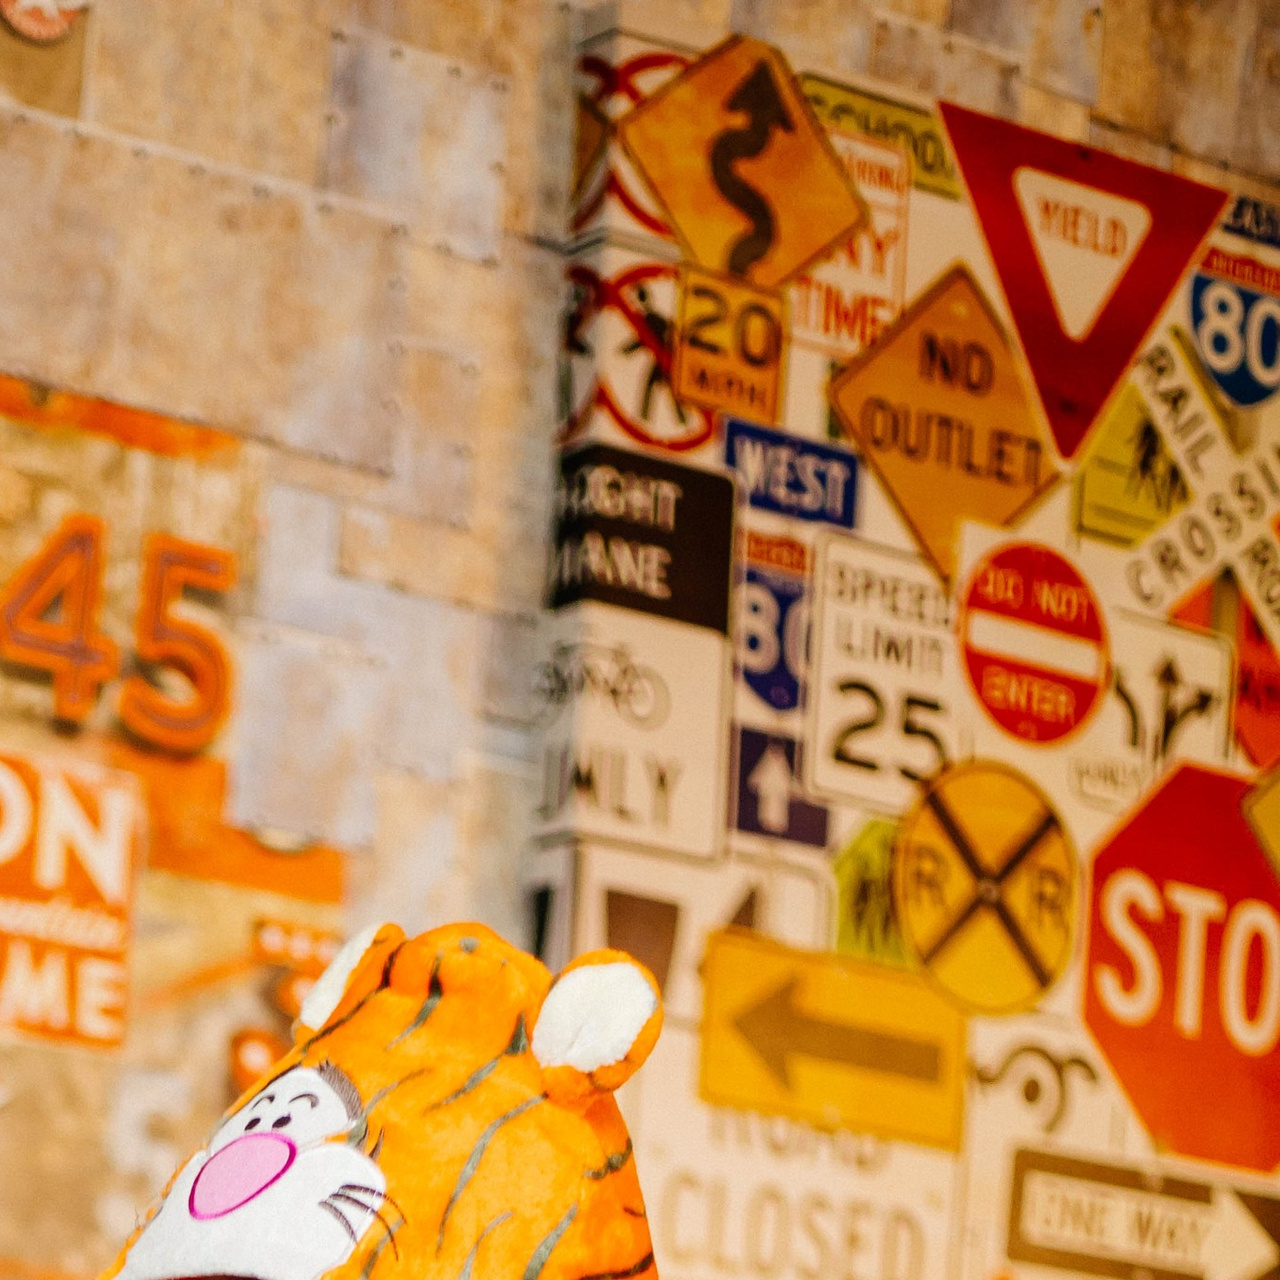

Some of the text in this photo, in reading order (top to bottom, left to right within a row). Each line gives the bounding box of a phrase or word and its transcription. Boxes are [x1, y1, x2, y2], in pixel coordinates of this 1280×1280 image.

[1035, 198, 1128, 258] YIELD
[687, 282, 783, 368] 20
[1197, 288, 1280, 388] 80
[918, 328, 995, 394] NO
[863, 397, 1046, 486] OUTLET
[1142, 342, 1218, 482] RAIL
[732, 433, 852, 518] WEST
[832, 562, 954, 628] SPEED
[978, 566, 1020, 608] DO
[1034, 576, 1092, 624] NOT
[835, 614, 946, 673] LIMIT
[981, 666, 1076, 726] ENTER
[833, 680, 949, 782] 25
